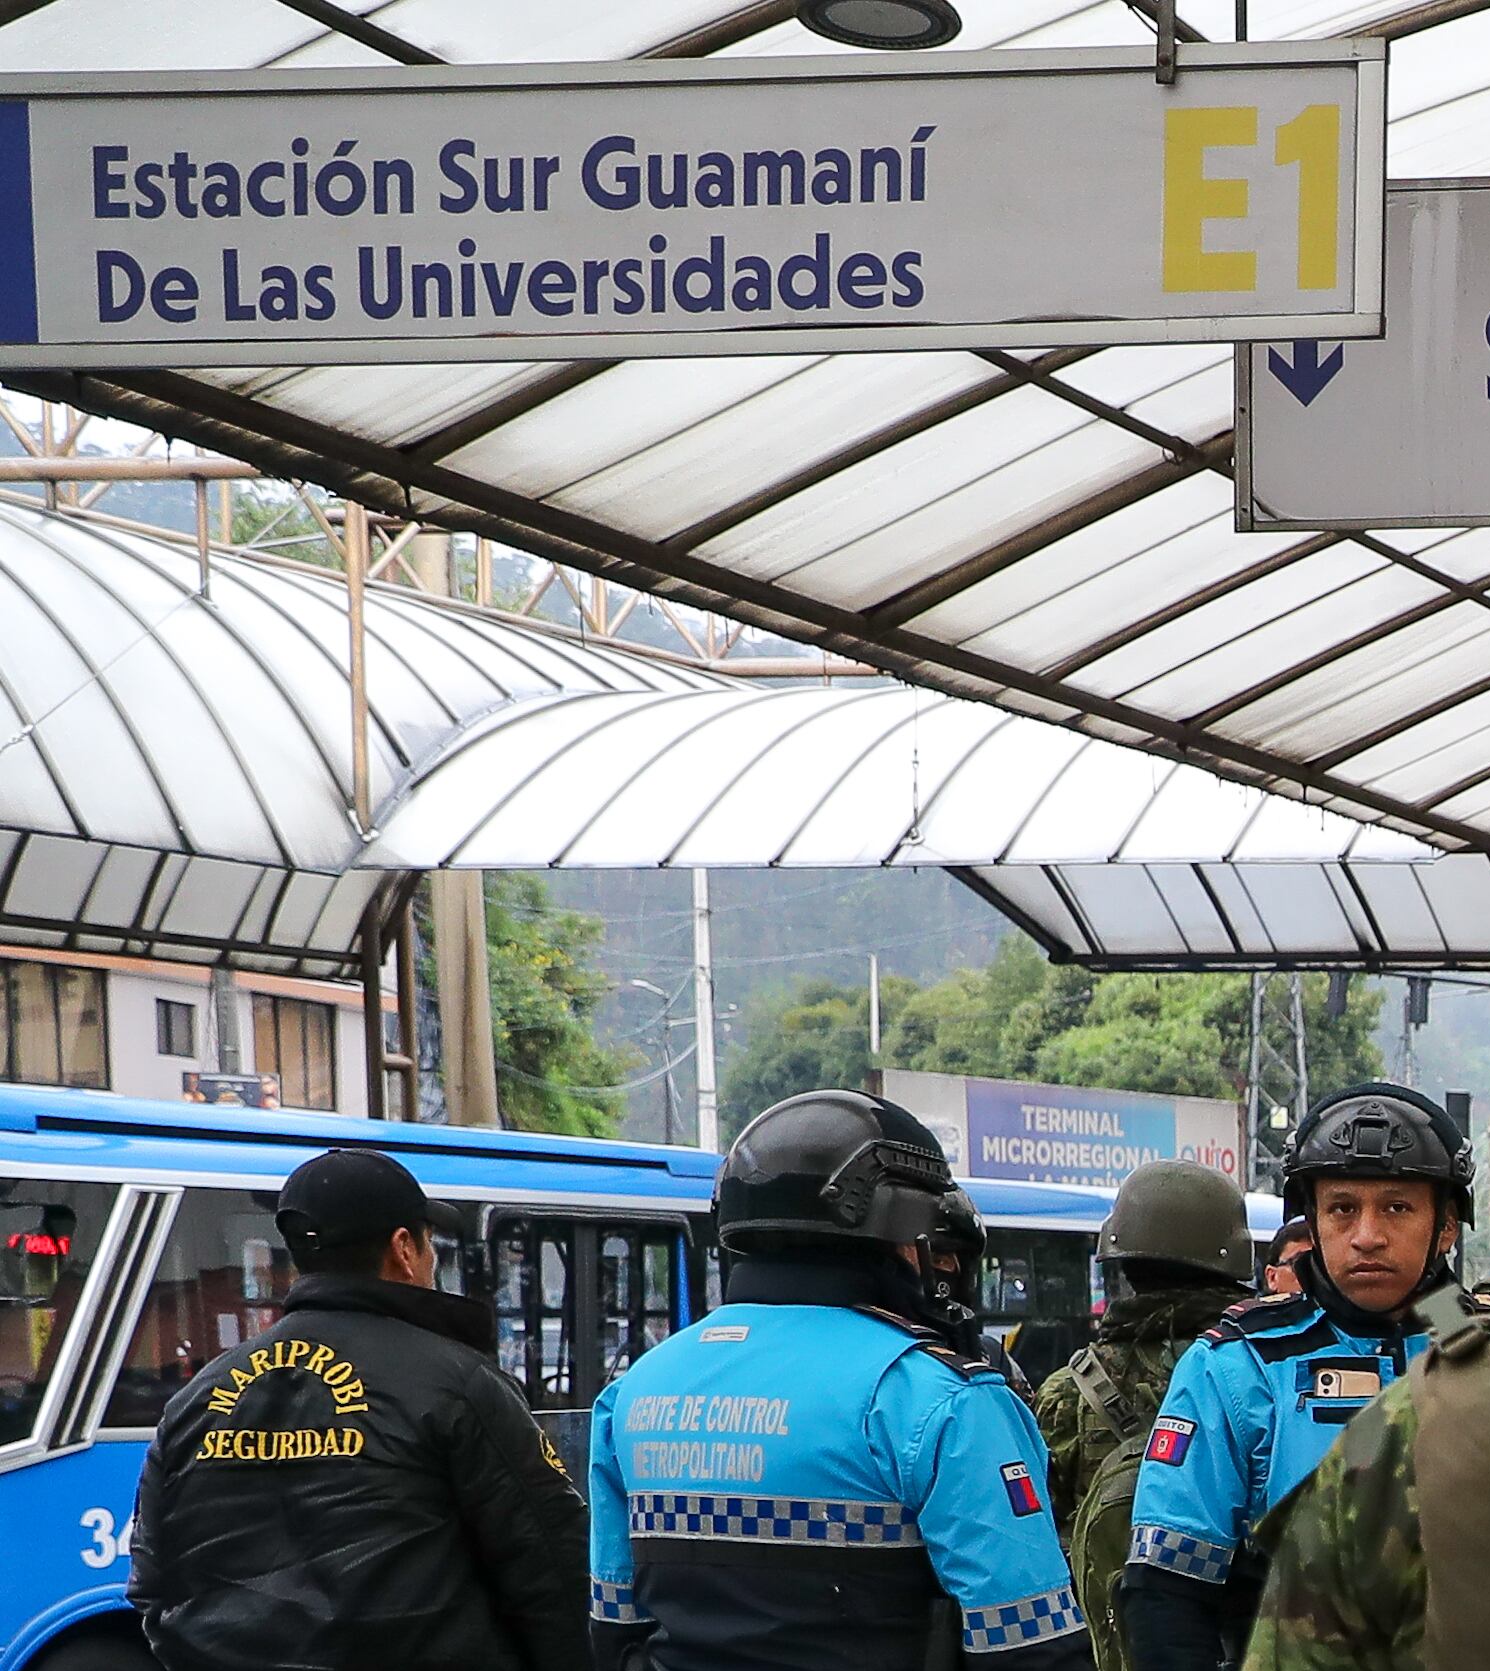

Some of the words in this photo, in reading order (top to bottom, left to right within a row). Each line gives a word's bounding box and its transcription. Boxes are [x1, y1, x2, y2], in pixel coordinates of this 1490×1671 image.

[91, 137, 415, 220] Estación
[438, 138, 560, 213] Sur
[580, 125, 938, 211] Guamaní
[1161, 103, 1341, 294] E1
[95, 249, 200, 324] De
[222, 248, 337, 322] Las
[358, 232, 925, 320] Universidades
[1021, 1104, 1125, 1138] TERMINAL
[207, 1339, 370, 1416] MARIPROBI
[625, 1395, 681, 1433] AGENTE
[679, 1394, 707, 1432] DE
[706, 1395, 790, 1436] CONTROL
[195, 1427, 365, 1461] SEGURIDAD
